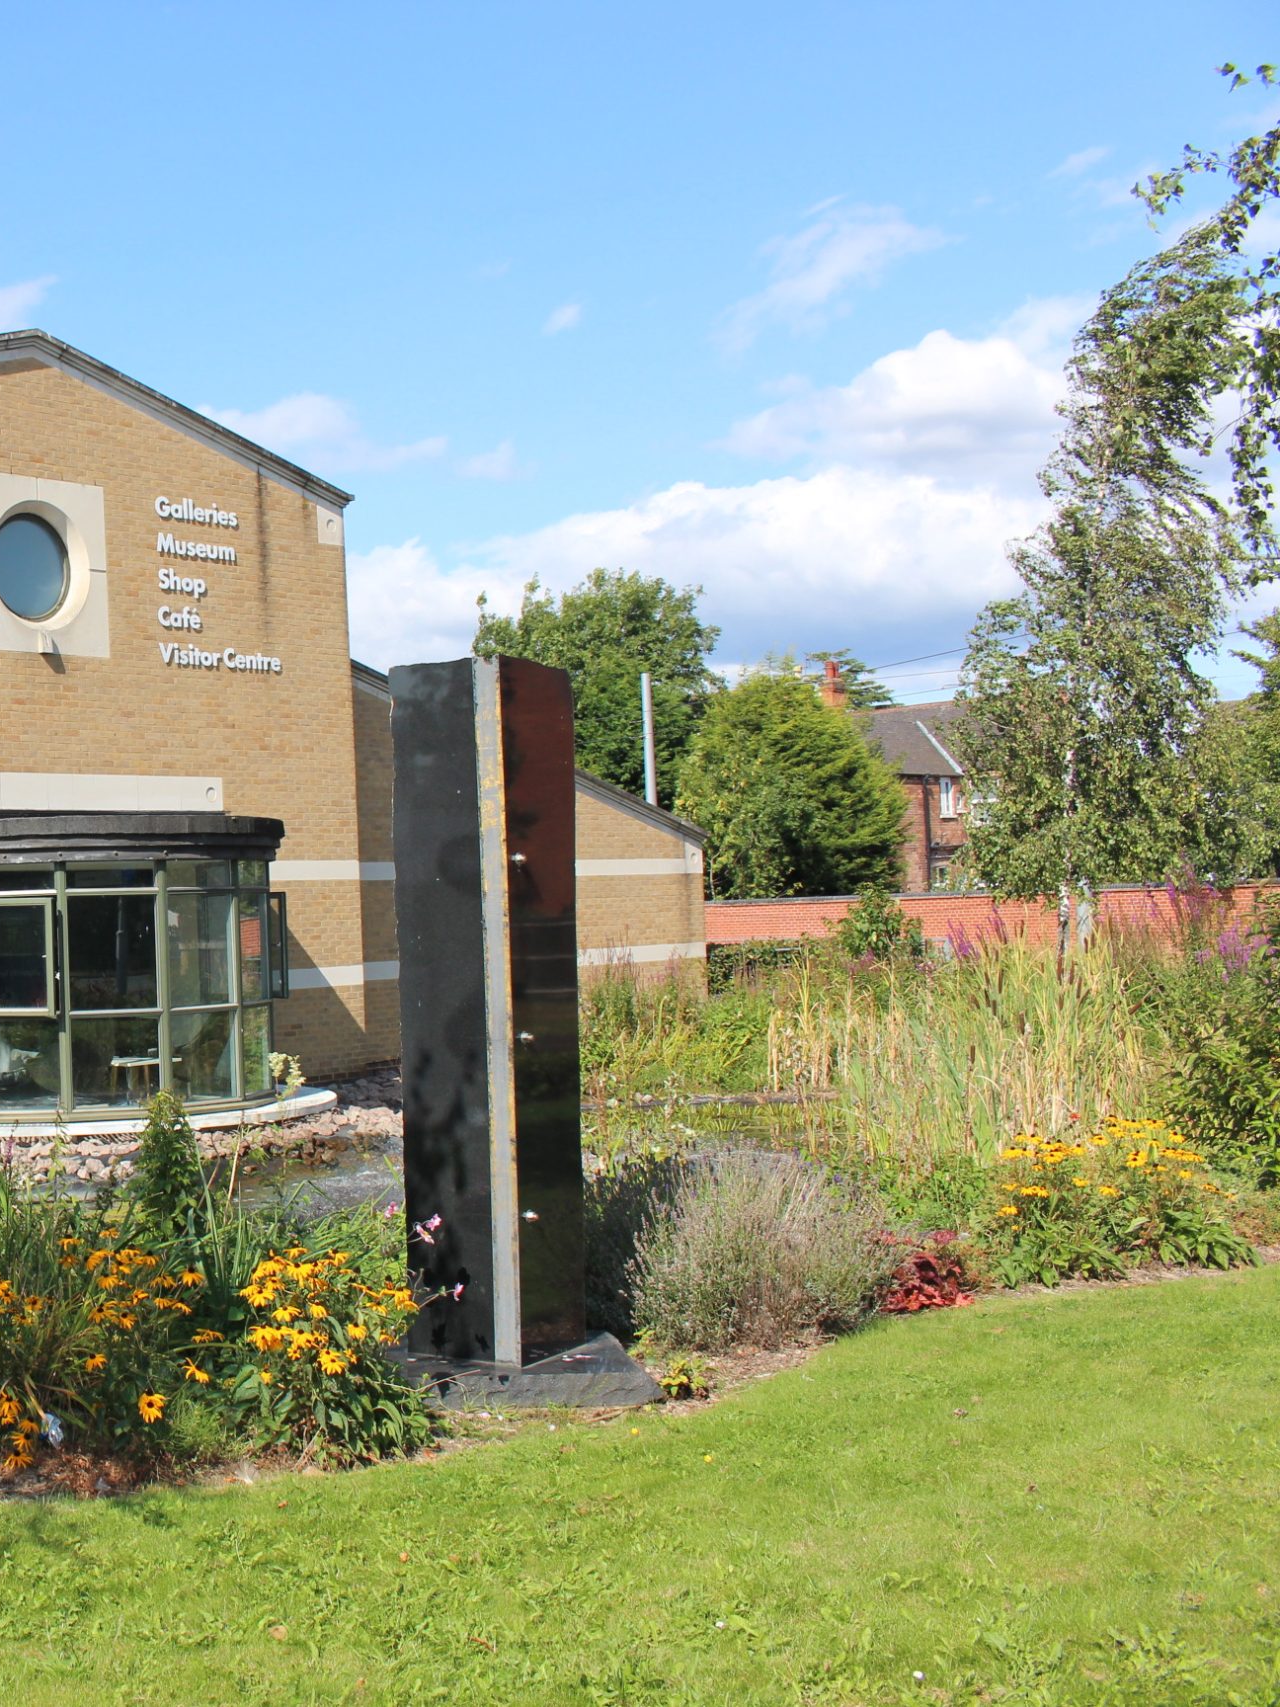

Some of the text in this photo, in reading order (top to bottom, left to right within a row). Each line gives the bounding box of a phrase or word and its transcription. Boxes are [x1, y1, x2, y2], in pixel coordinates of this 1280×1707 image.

[155, 496, 238, 527] Galleries
[157, 532, 235, 561] Museum
[158, 568, 205, 598] Shop
[157, 606, 201, 629] Café
[159, 642, 281, 672] Visitor Centre
